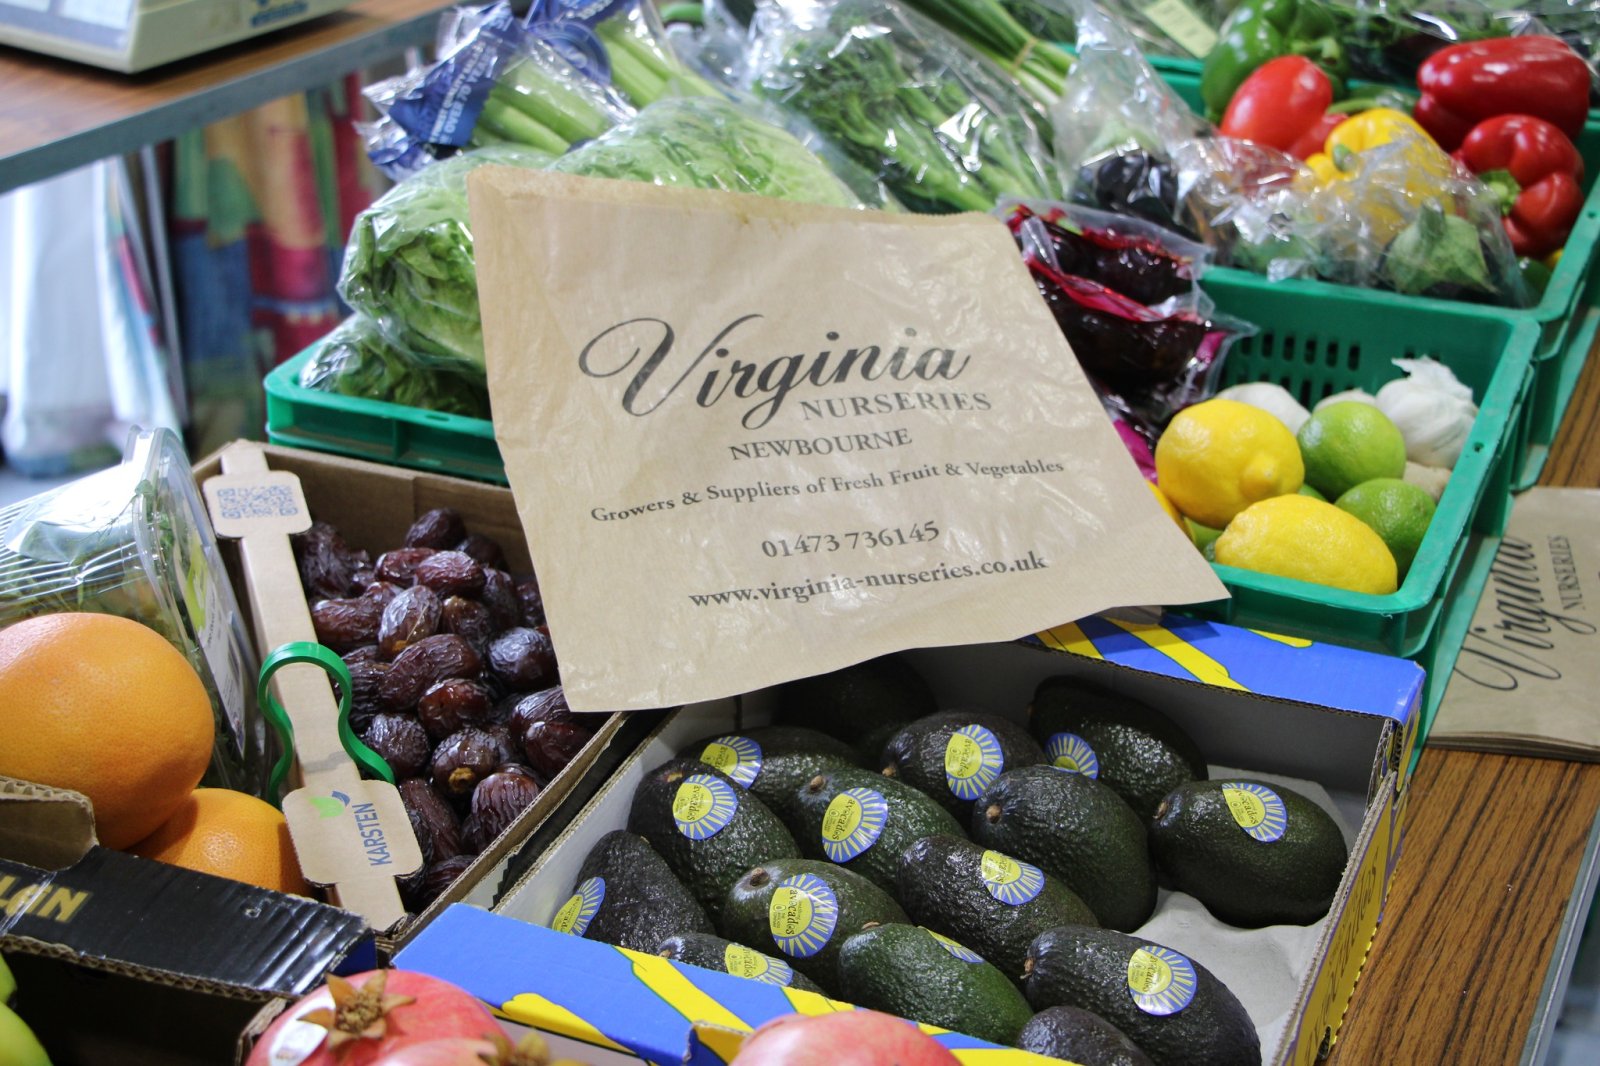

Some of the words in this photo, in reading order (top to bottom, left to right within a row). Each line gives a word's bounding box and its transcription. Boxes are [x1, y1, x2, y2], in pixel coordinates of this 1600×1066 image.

[443, 101, 465, 134] OVER
[578, 313, 972, 431] Virginia
[798, 391, 992, 421] NURSERIES
[728, 428, 913, 461] NEWBOURNE
[591, 498, 675, 522] Growers
[682, 491, 703, 506] &
[706, 481, 800, 503] Suppliers
[806, 477, 827, 495] of
[831, 472, 884, 492] Fresh
[889, 464, 940, 485] Fruit
[945, 462, 963, 476] &
[966, 459, 1065, 480] Vegetables
[761, 534, 841, 558] 01473
[844, 520, 940, 550] 736145
[688, 550, 1048, 608] www.virginia-nurseries.co.uk
[1547, 535, 1585, 611] NURSERIES
[1453, 535, 1597, 692] Virginia
[686, 785, 702, 821] avocados
[832, 799, 856, 841] avocados
[351, 802, 393, 867] KARSTEN
[785, 889, 799, 935] avocados
